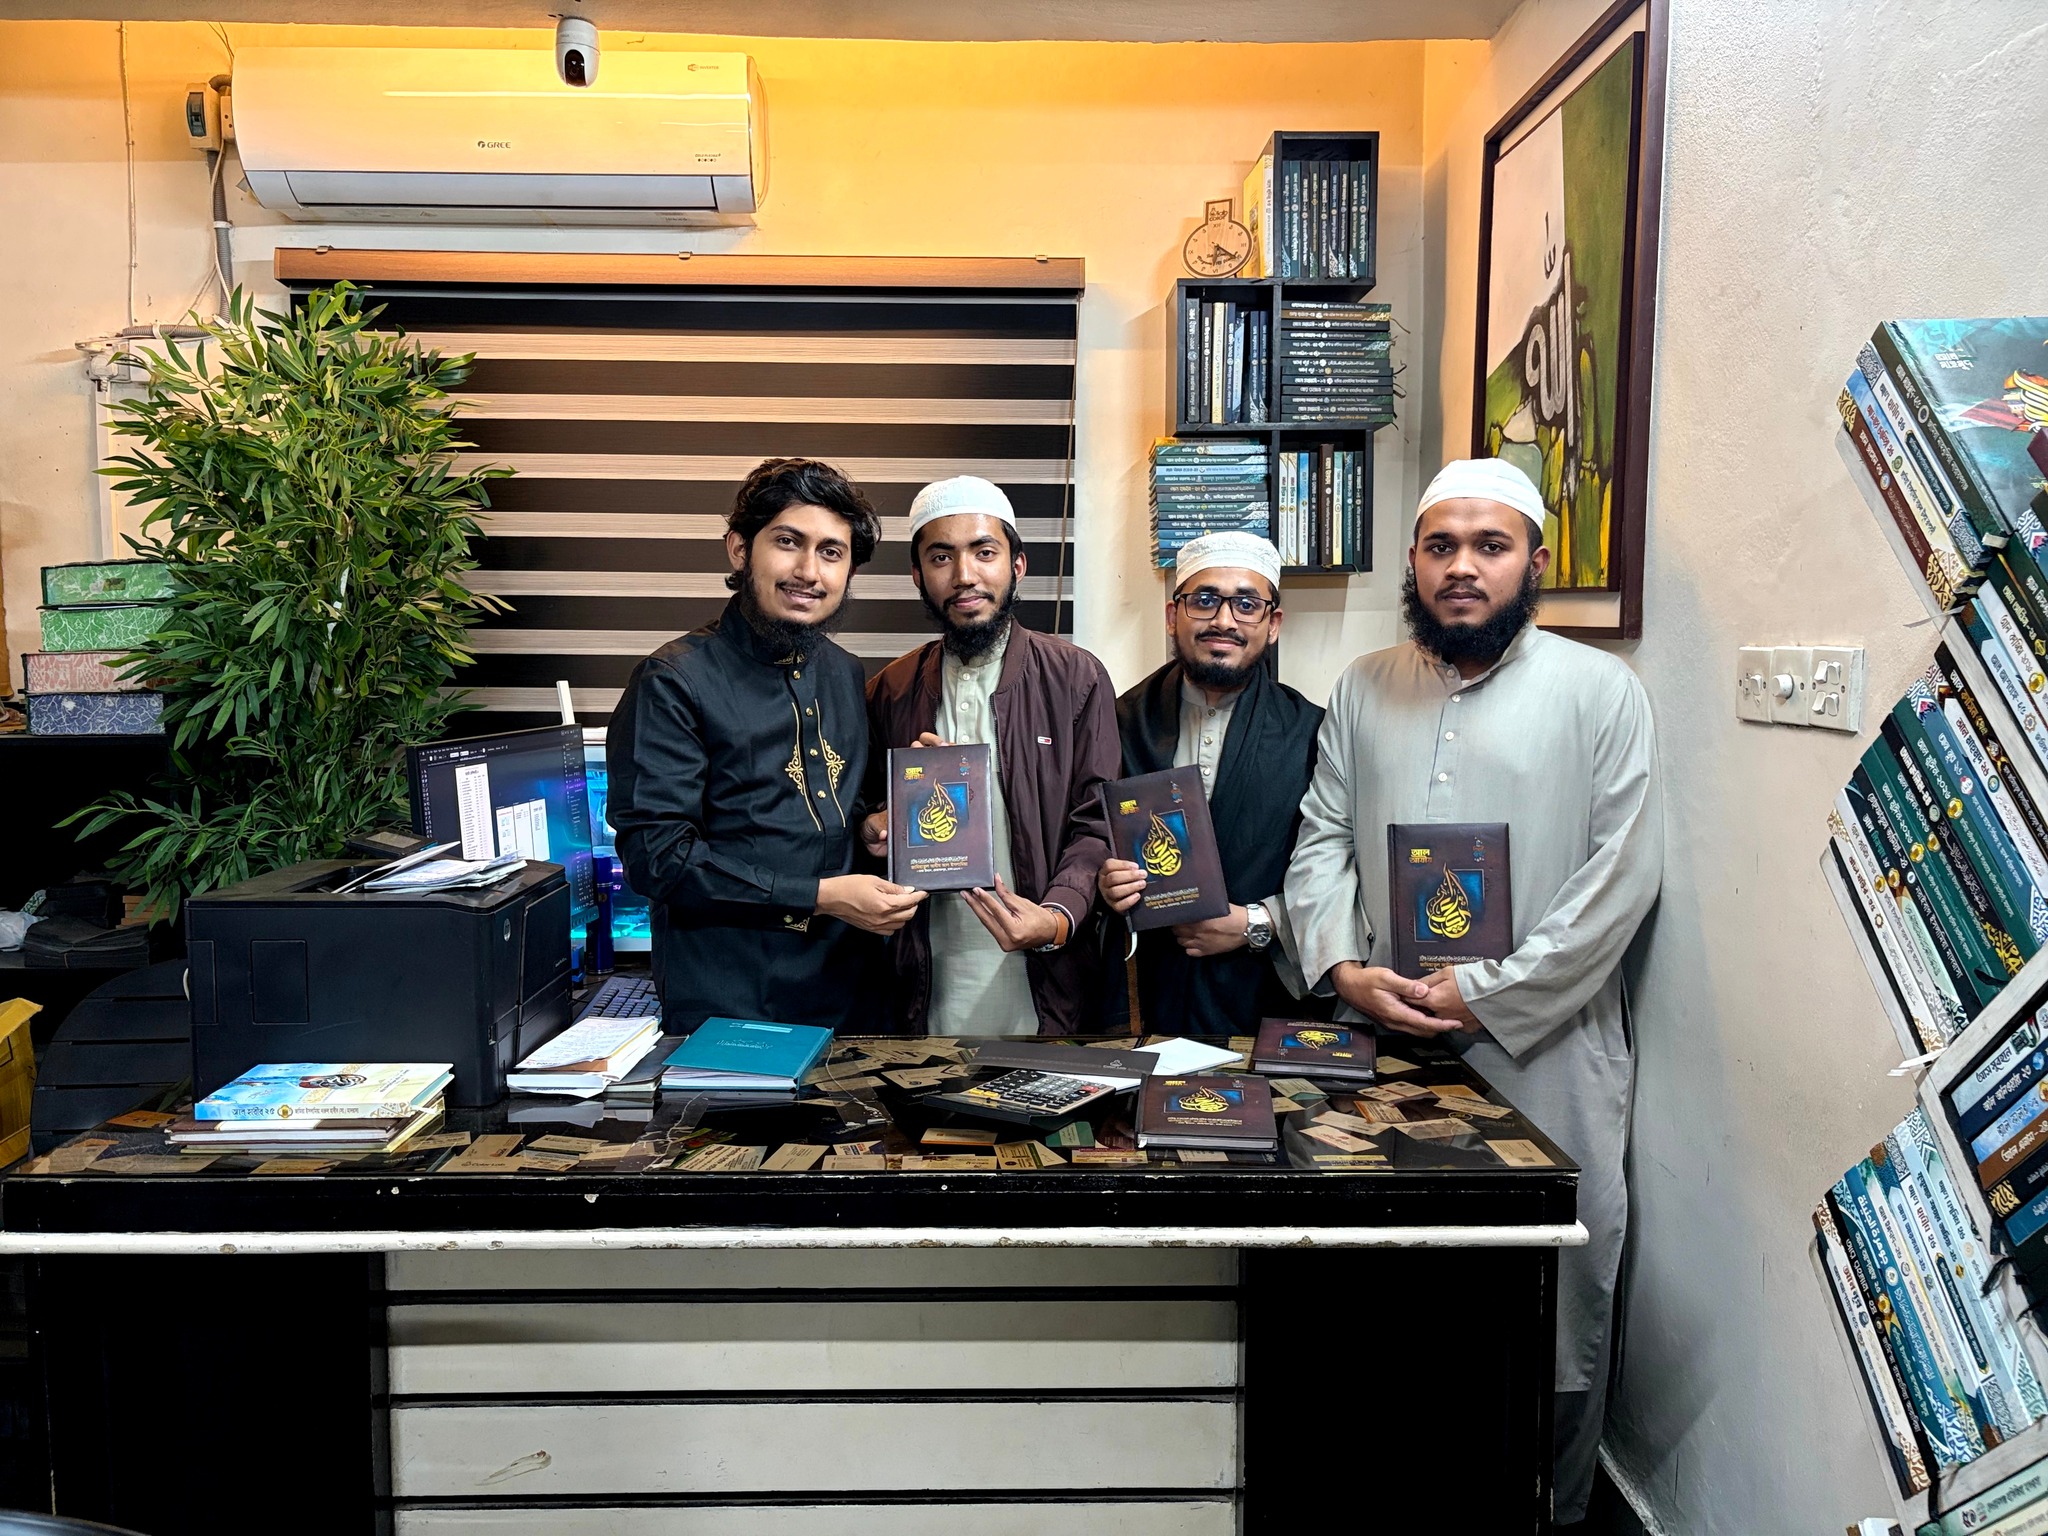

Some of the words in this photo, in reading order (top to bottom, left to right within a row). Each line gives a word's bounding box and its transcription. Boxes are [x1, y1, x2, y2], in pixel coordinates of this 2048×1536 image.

[1950, 669, 1963, 691] আল
[1917, 737, 1928, 755] আল
[1955, 717, 1968, 737] আল
[1980, 761, 1989, 776] ২৬
[1897, 771, 1908, 789] আল
[1882, 782, 1892, 800] আল
[1862, 813, 1874, 832] আল
[1857, 1195, 1876, 1228] الجنينة
[1897, 1203, 1906, 1221] আল
[1908, 1184, 1919, 1205] আল
[1916, 1207, 1930, 1231] হাবীব
[1927, 1233, 1936, 1248] ২৬
[1845, 1238, 1856, 1259] আর
[1855, 1231, 1864, 1249] আল
[1871, 1228, 1888, 1264] جوهرة
